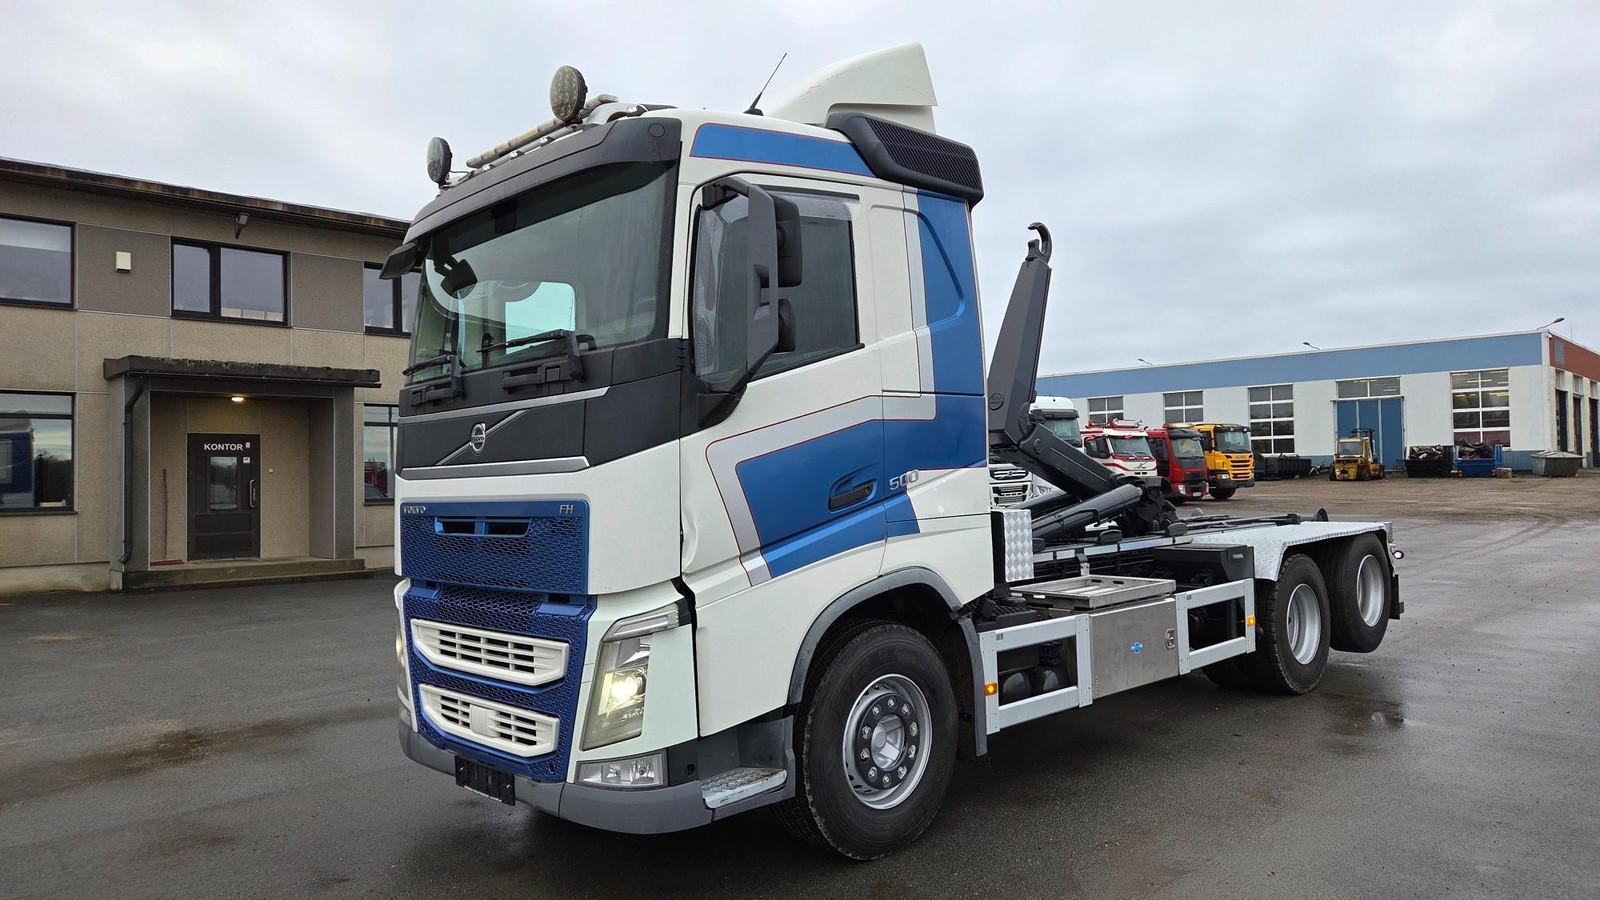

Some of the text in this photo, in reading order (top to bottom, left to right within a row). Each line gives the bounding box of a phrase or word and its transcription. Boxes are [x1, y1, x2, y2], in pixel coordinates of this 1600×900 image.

[204, 443, 244, 451] KONTOR
[889, 469, 919, 490] 500
[403, 505, 426, 514] VOLVO
[560, 504, 575, 515] FH
